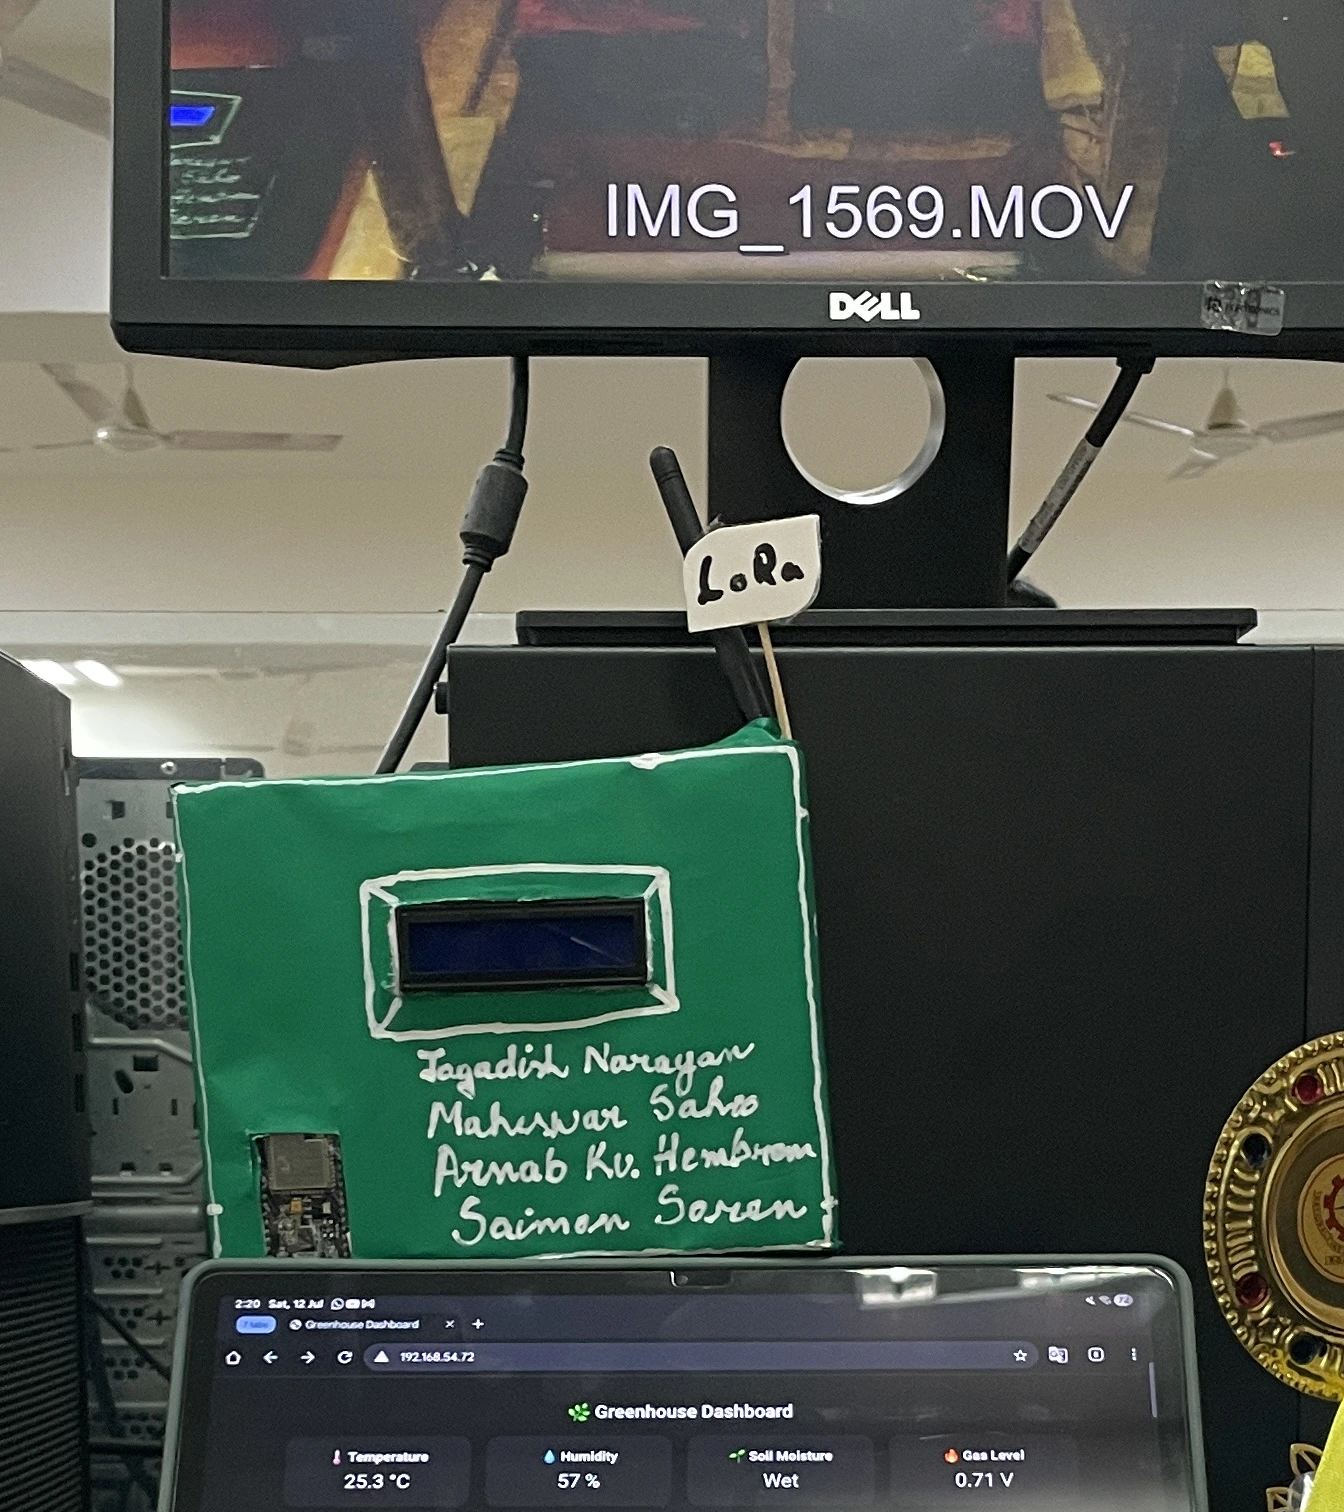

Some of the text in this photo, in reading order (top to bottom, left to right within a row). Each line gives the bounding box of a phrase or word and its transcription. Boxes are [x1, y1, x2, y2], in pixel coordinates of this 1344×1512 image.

[605, 184, 1134, 254] IMG_1569.MOV
[828, 291, 921, 321] DELL
[698, 544, 804, 604] LoRa
[584, 1042, 755, 1094] Narayan
[434, 1146, 569, 1196] Arnab
[268, 1299, 291, 1311] Sat,
[293, 1299, 306, 1309] 12
[305, 1318, 420, 1329] Greenhouse Dashboard
[400, 1352, 475, 1363] 192.168.54.72
[594, 1404, 794, 1420] Greenhouse Dashboard
[347, 1451, 429, 1465] Temperature
[560, 1450, 618, 1465] Humidity
[749, 1449, 833, 1463] Soil Moisture
[963, 1449, 1025, 1461] Gas Level
[344, 1474, 411, 1489] 25.3 °C
[557, 1474, 601, 1489] 57 %
[762, 1472, 800, 1489] Wet
[955, 1472, 1014, 1488] 0.71 V
